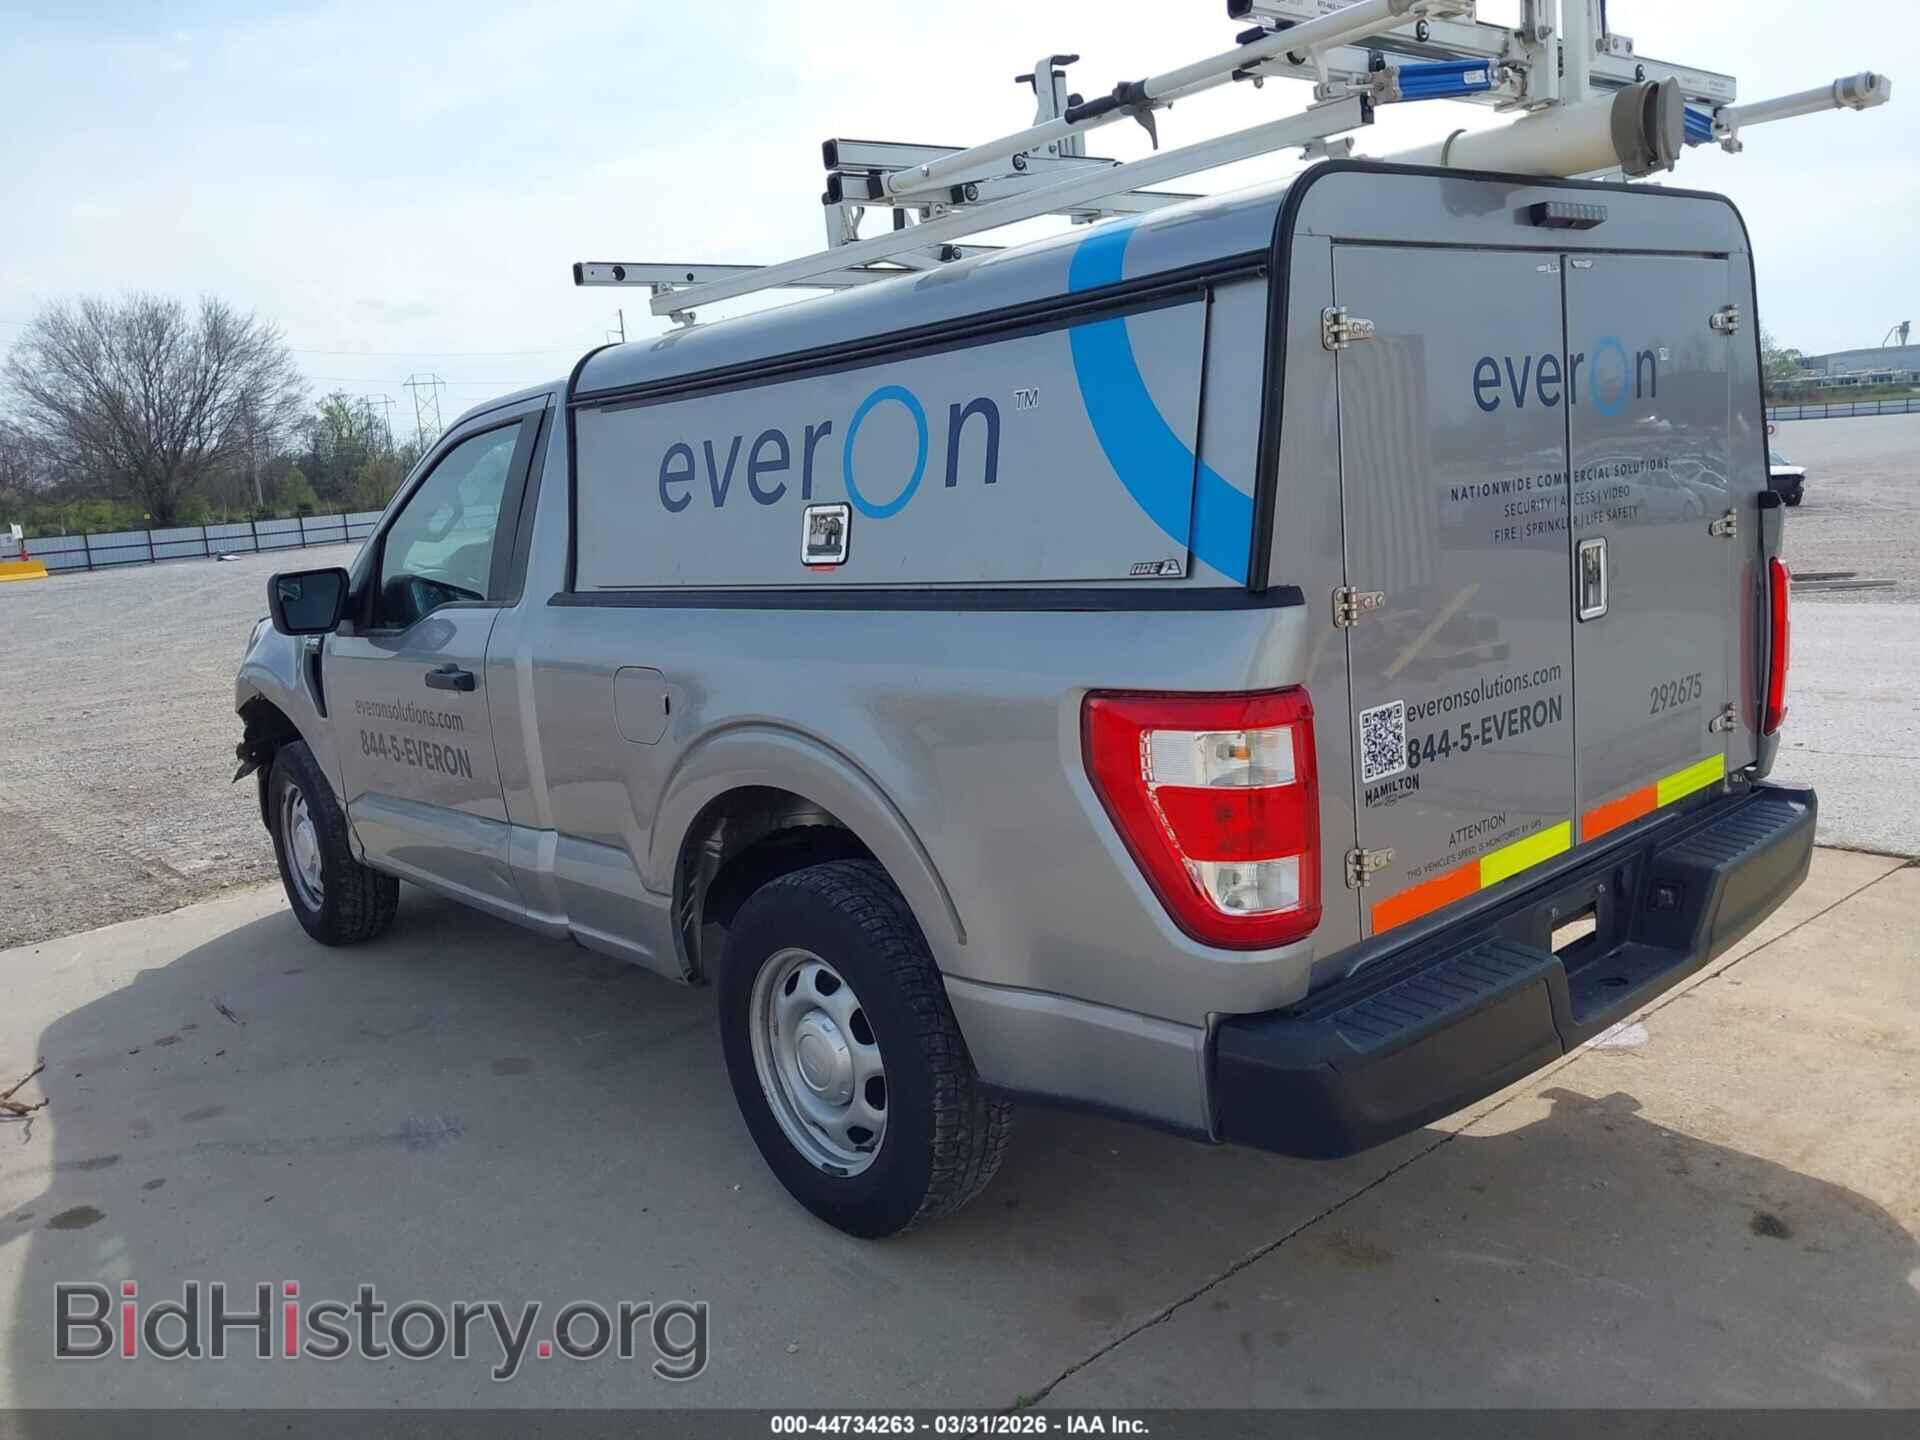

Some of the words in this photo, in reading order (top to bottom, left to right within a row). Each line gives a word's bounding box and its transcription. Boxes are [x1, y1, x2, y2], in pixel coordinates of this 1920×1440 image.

[1473, 335, 1656, 416] everOn
[658, 384, 1000, 520] everOn
[1015, 388, 1039, 410] TM
[1450, 476, 1532, 503] NATIONWIDE
[1614, 457, 1669, 478] SOLUTIONS
[1503, 498, 1552, 519] SECURITY
[1560, 490, 1596, 506] ACESS
[1603, 484, 1631, 501] VIDEO
[1494, 526, 1517, 542] FIRE
[1526, 514, 1578, 538] SPRINKLR
[1586, 509, 1604, 526] LIFE
[1606, 504, 1638, 522] SAFETY
[354, 696, 465, 732] everonsolutions.com
[1406, 664, 1562, 723] everonsolutions.com
[1649, 671, 1702, 714] 292675
[1407, 695, 1563, 769] 844-5-EVERON
[360, 729, 473, 780] 844-5-EVERON
[1364, 773, 1420, 809] HAMILTON
[1448, 811, 1507, 849] ATTENTION
